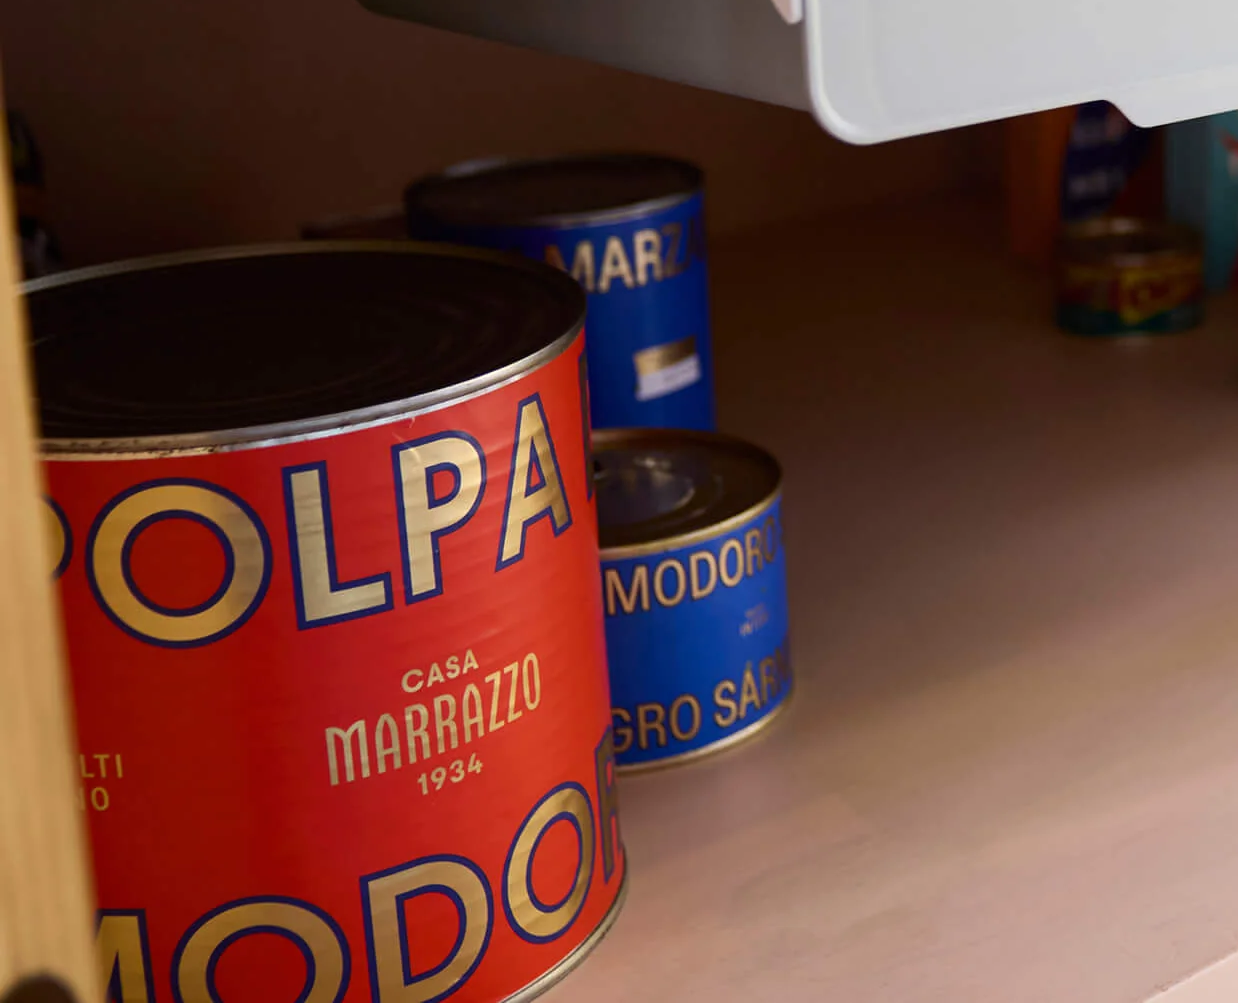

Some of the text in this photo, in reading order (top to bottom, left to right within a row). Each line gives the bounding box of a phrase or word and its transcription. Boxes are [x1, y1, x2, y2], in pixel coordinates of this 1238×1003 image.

[49, 392, 573, 650] OLPA
[401, 649, 479, 693] CASA
[325, 652, 541, 786] MARRAZZO
[417, 753, 483, 796] 1934
